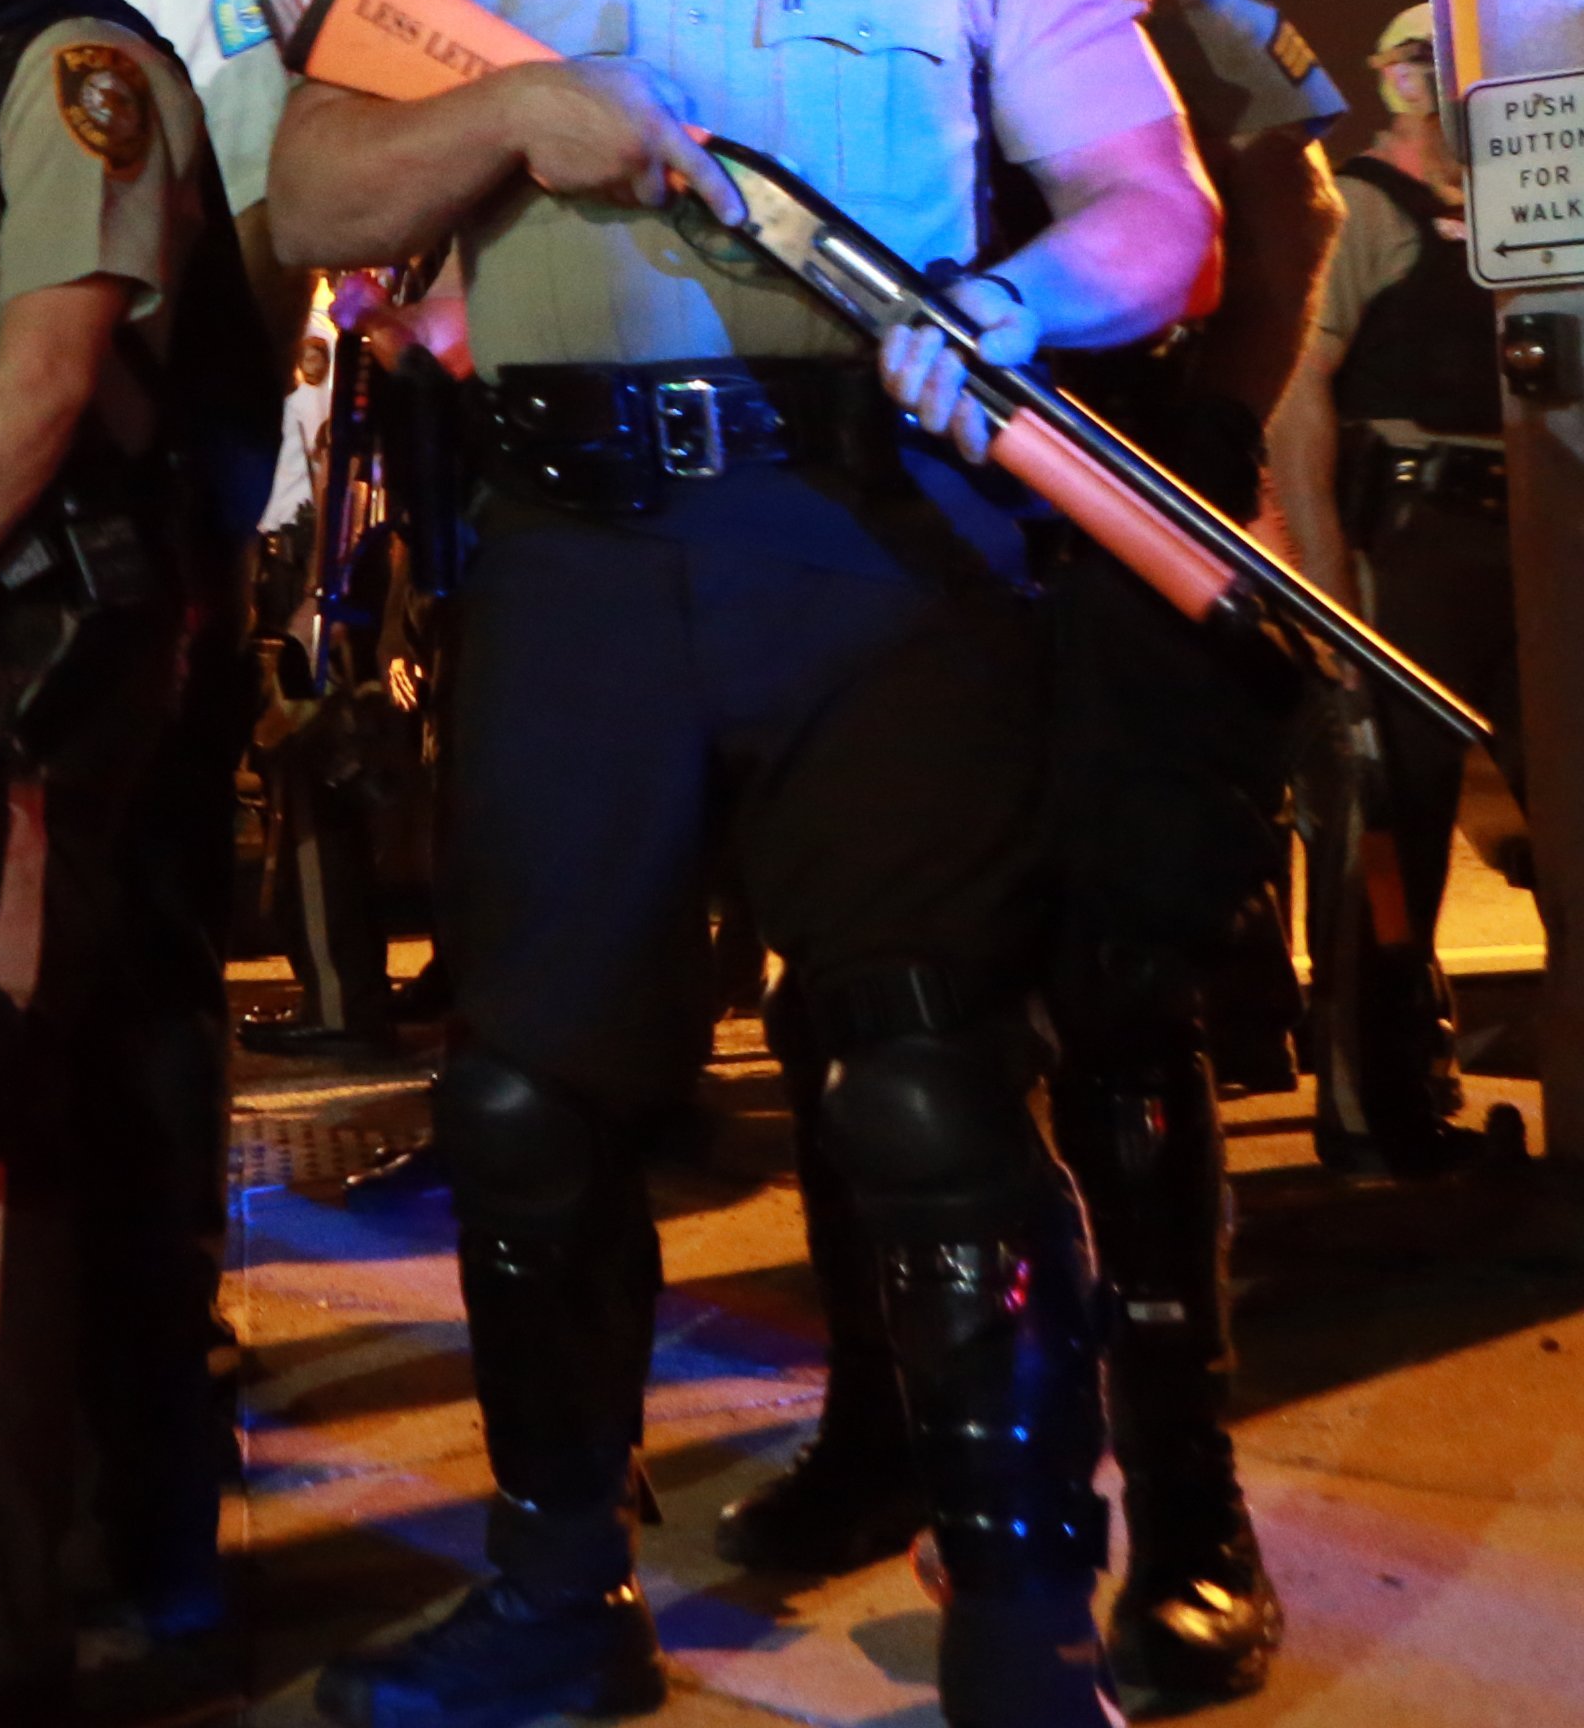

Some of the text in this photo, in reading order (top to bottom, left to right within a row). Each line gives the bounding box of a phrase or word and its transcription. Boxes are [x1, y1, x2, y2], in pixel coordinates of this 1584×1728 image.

[424, 30, 499, 77] LET
[1505, 94, 1576, 121] PUSH
[1520, 165, 1570, 188] FOR
[1510, 198, 1583, 224] WALK
